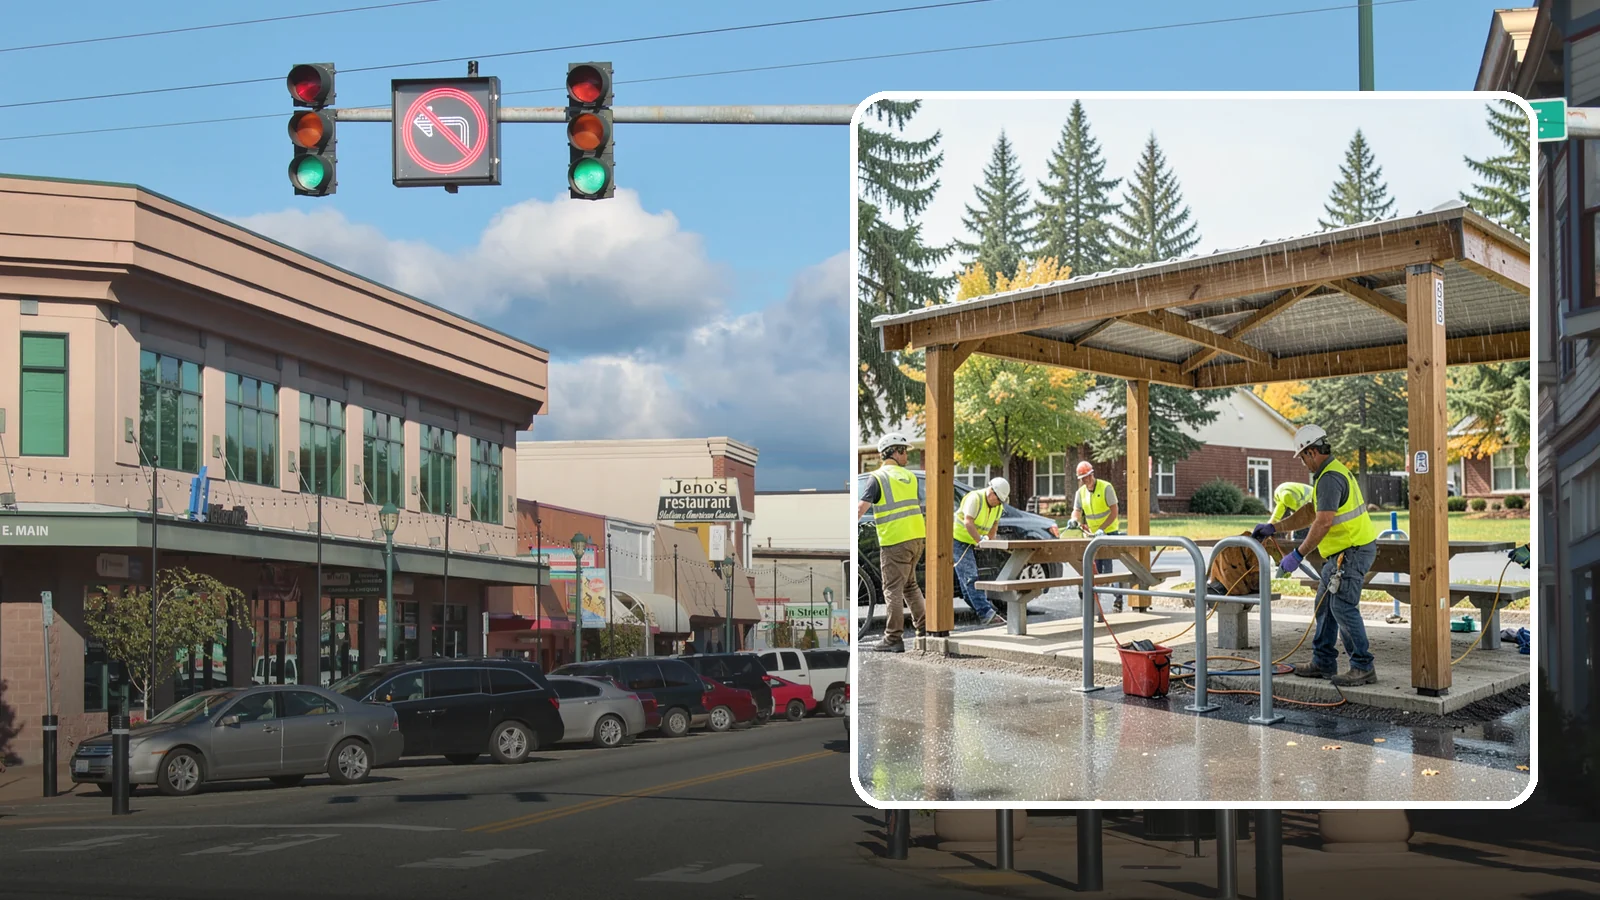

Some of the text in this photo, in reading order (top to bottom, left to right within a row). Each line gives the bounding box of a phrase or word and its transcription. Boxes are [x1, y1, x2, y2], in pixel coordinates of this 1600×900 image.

[670, 480, 727, 494] Jeno's
[665, 496, 731, 509] restaurant
[658, 510, 681, 519] Italian
[686, 510, 715, 519] American
[715, 509, 737, 519] Cuisine
[2, 525, 49, 536] E. MAIN
[797, 608, 828, 616] Street
